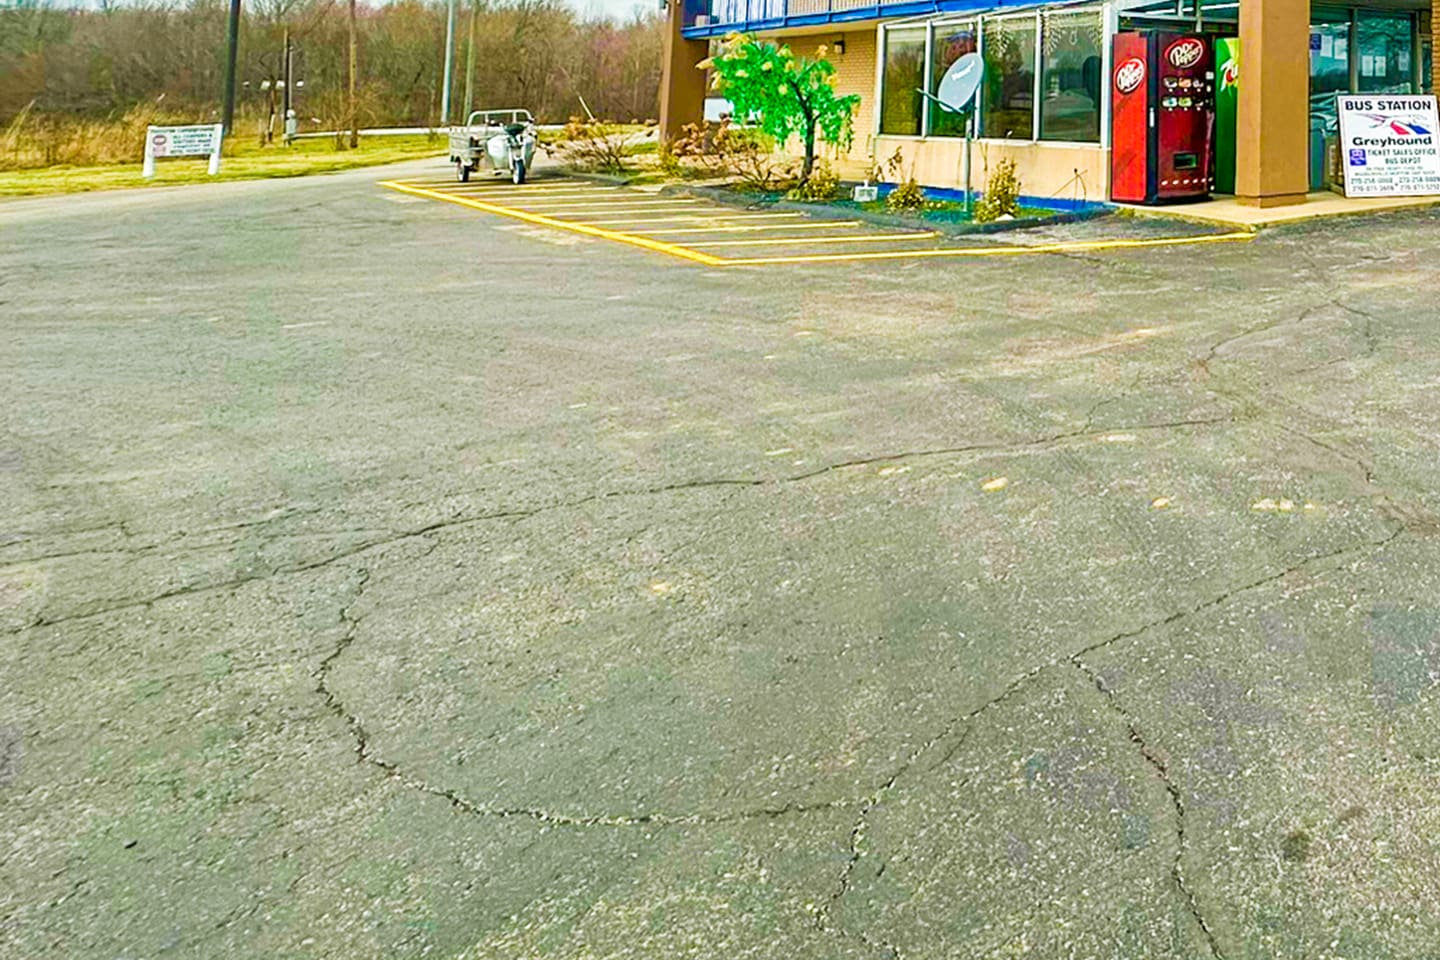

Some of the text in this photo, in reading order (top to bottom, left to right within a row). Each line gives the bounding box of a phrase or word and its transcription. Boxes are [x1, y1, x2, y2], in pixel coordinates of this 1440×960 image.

[1345, 100, 1431, 111] BUS STATION
[1352, 136, 1432, 147] Greyhound
[1368, 148, 1390, 156] TICKET
